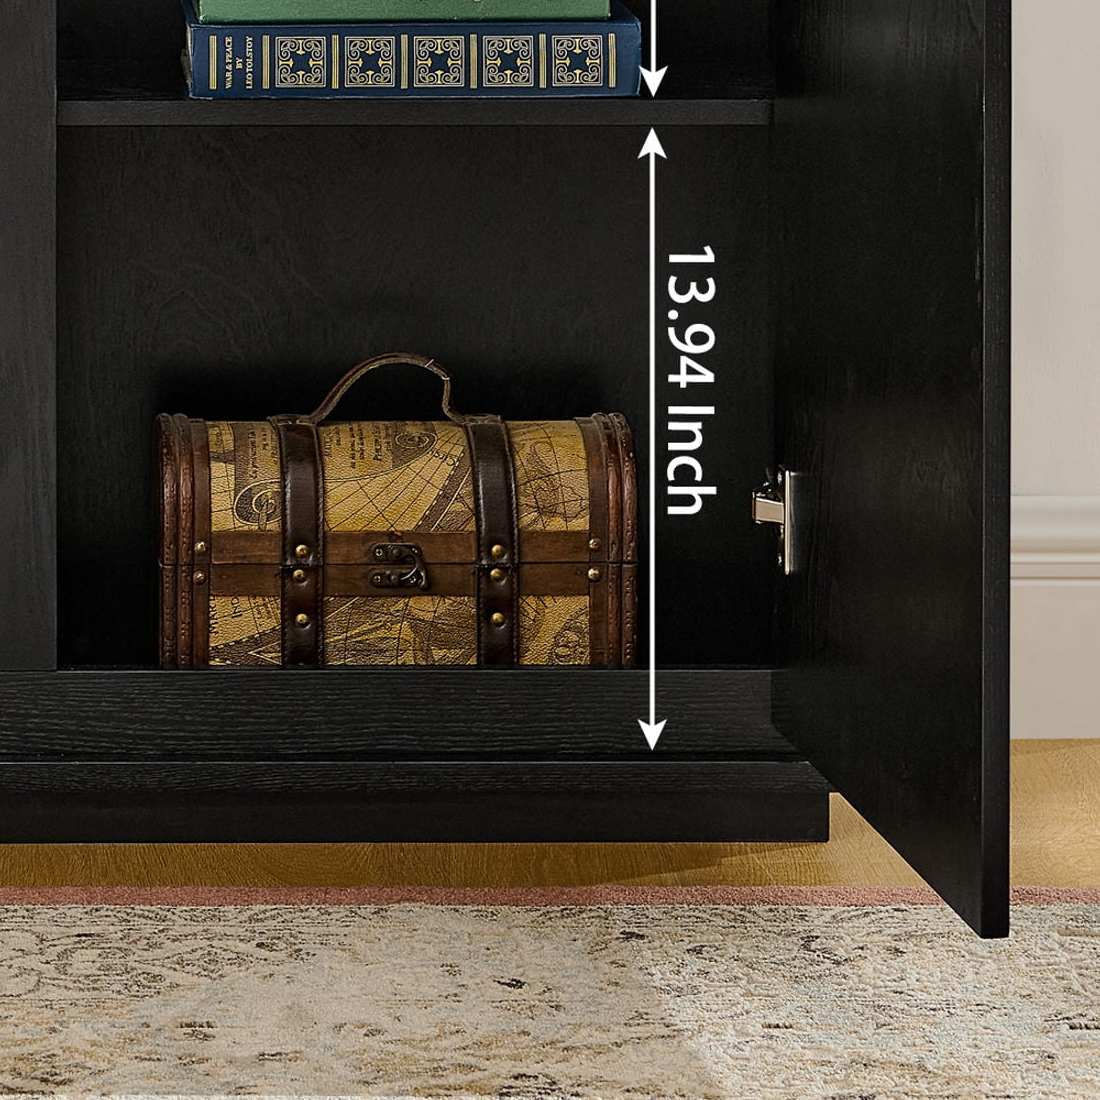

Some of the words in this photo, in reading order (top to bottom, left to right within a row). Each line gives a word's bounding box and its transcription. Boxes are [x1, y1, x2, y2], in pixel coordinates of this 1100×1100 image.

[225, 36, 233, 63] PEACE
[245, 36, 253, 72] TOLSTOY
[235, 57, 243, 69] BY
[225, 72, 233, 89] WAR
